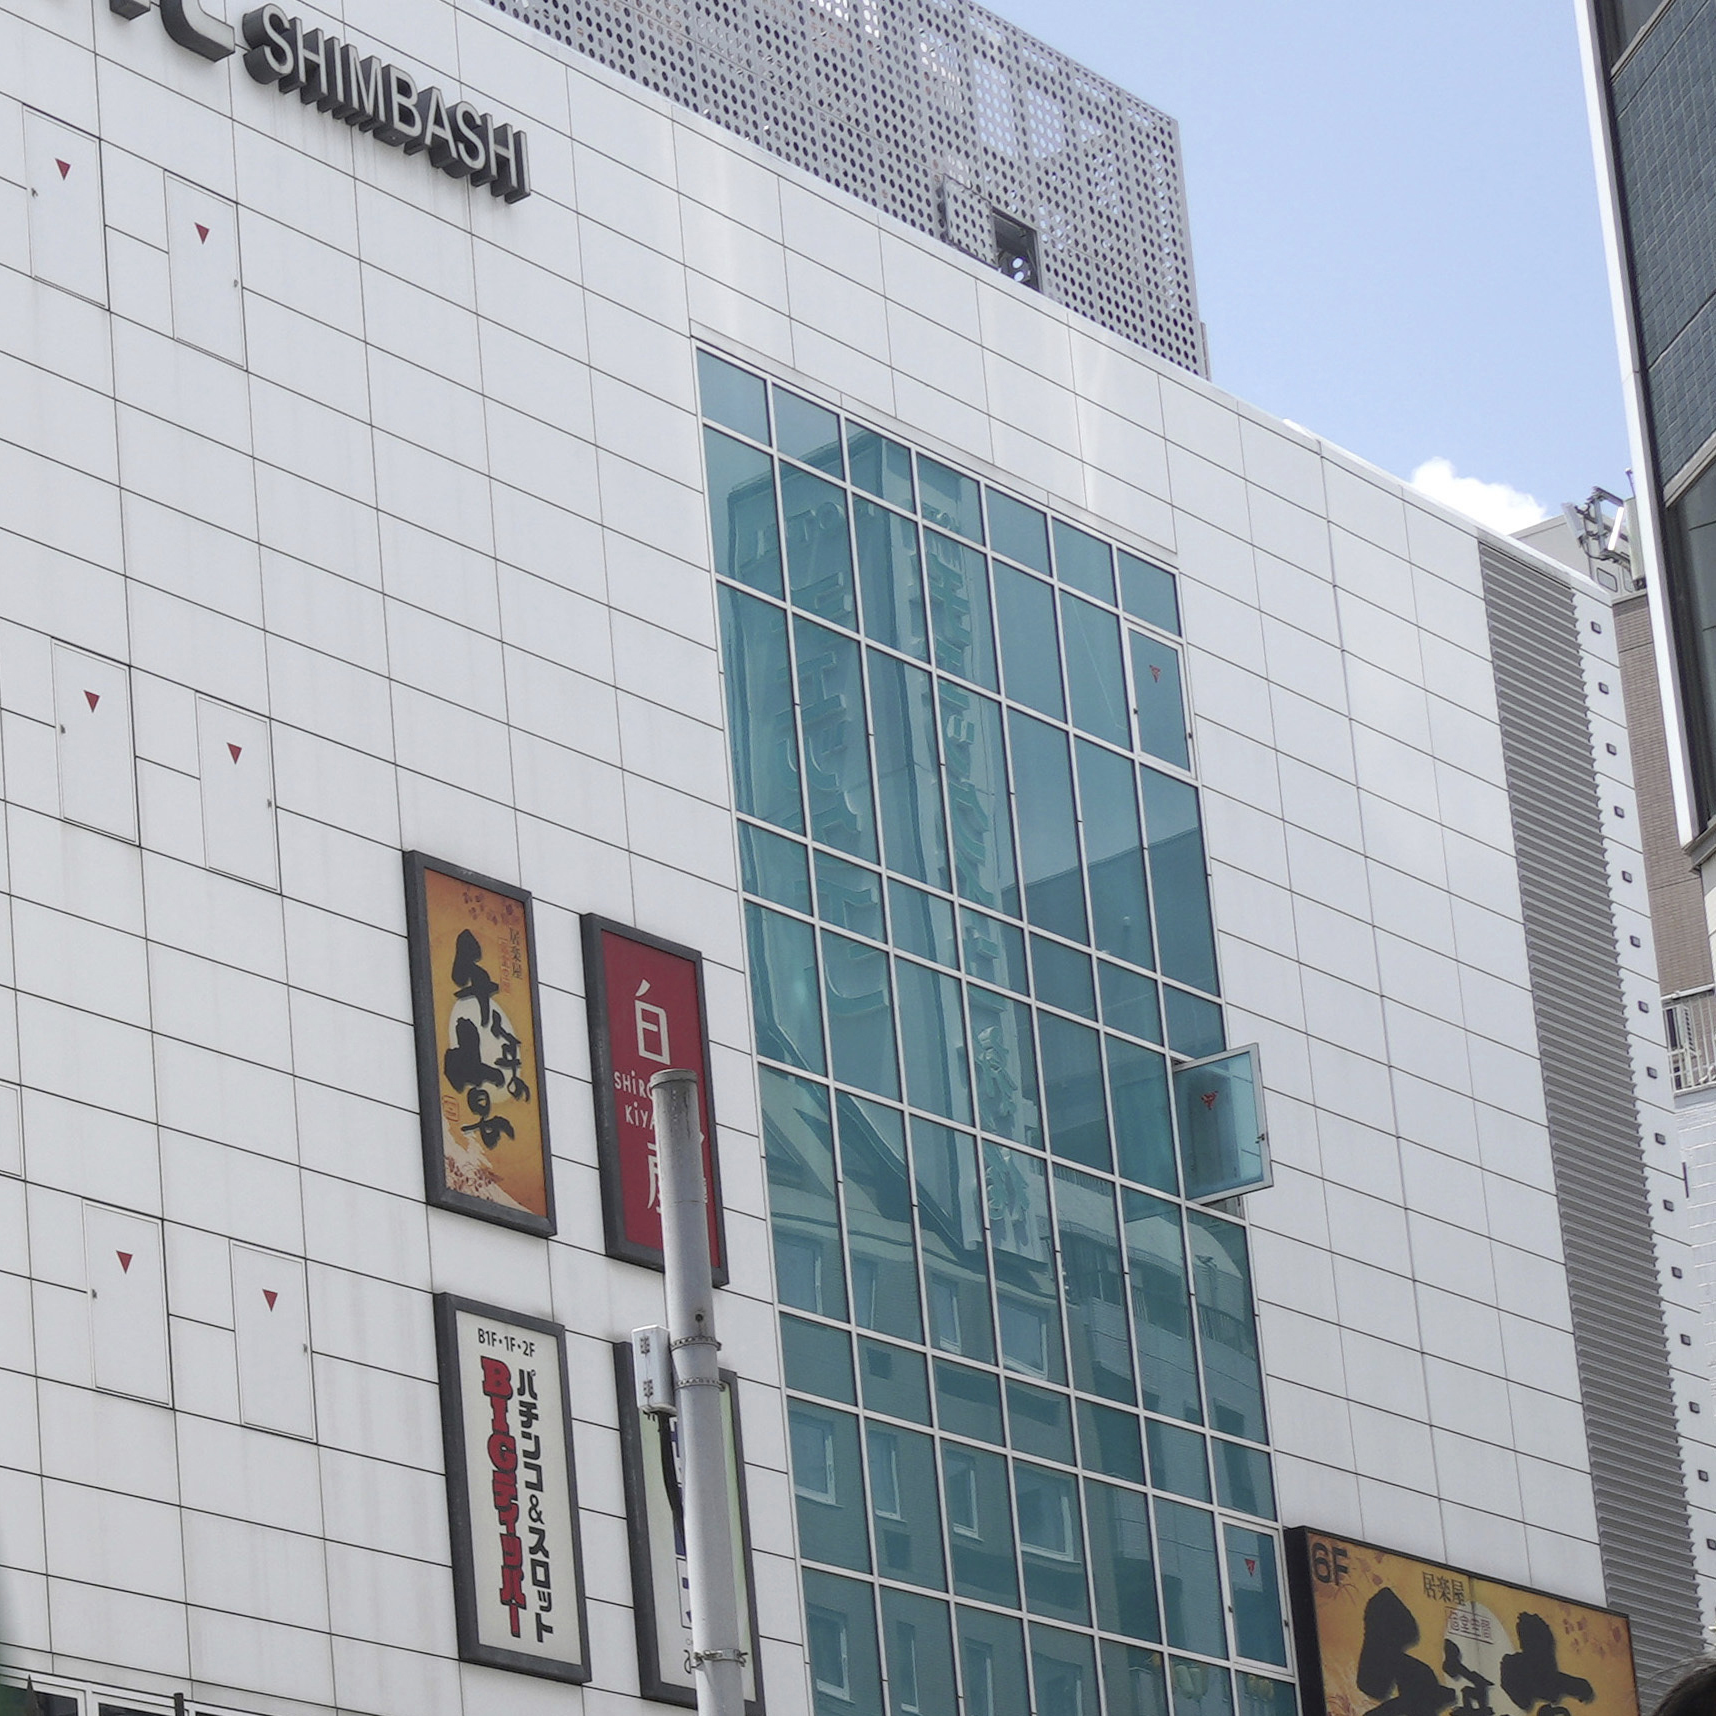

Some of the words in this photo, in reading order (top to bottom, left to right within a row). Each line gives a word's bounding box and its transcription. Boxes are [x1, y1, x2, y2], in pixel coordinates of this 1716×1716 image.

[243, 5, 531, 204] SHIMBASHI
[517, 1368, 554, 1643] パチンコ&スロット
[1312, 1541, 1350, 1586] 6F
